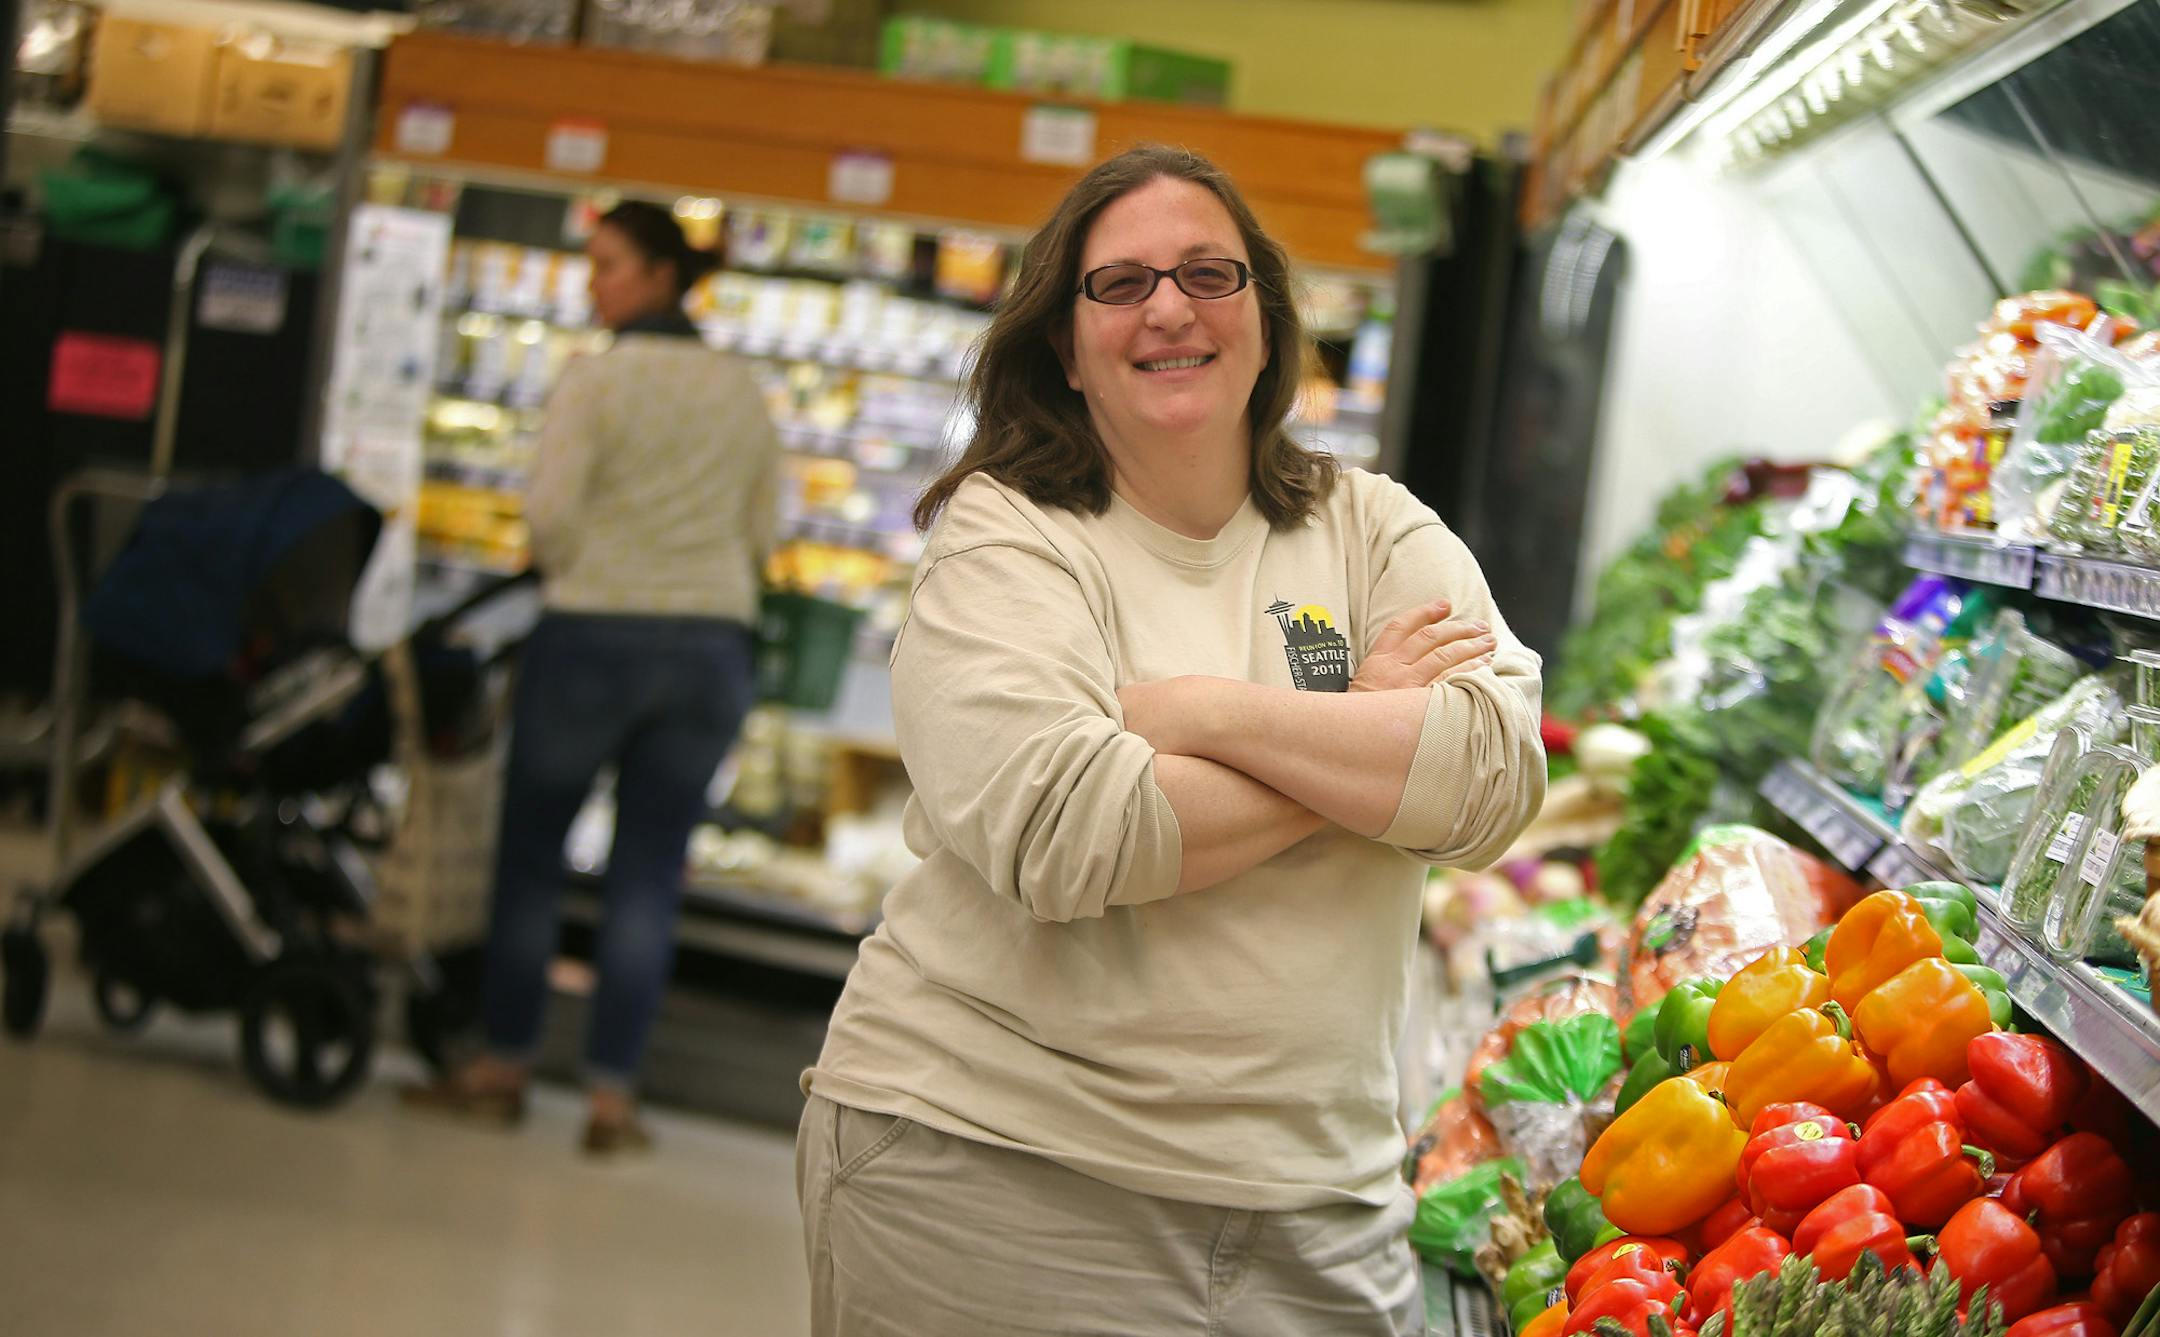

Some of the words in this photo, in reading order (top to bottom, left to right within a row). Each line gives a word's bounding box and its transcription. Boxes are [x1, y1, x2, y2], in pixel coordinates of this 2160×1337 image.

[1298, 642, 1326, 651] REUNION
[1301, 649, 1346, 664] SEATTLE
[1311, 664, 1342, 676] 2011
